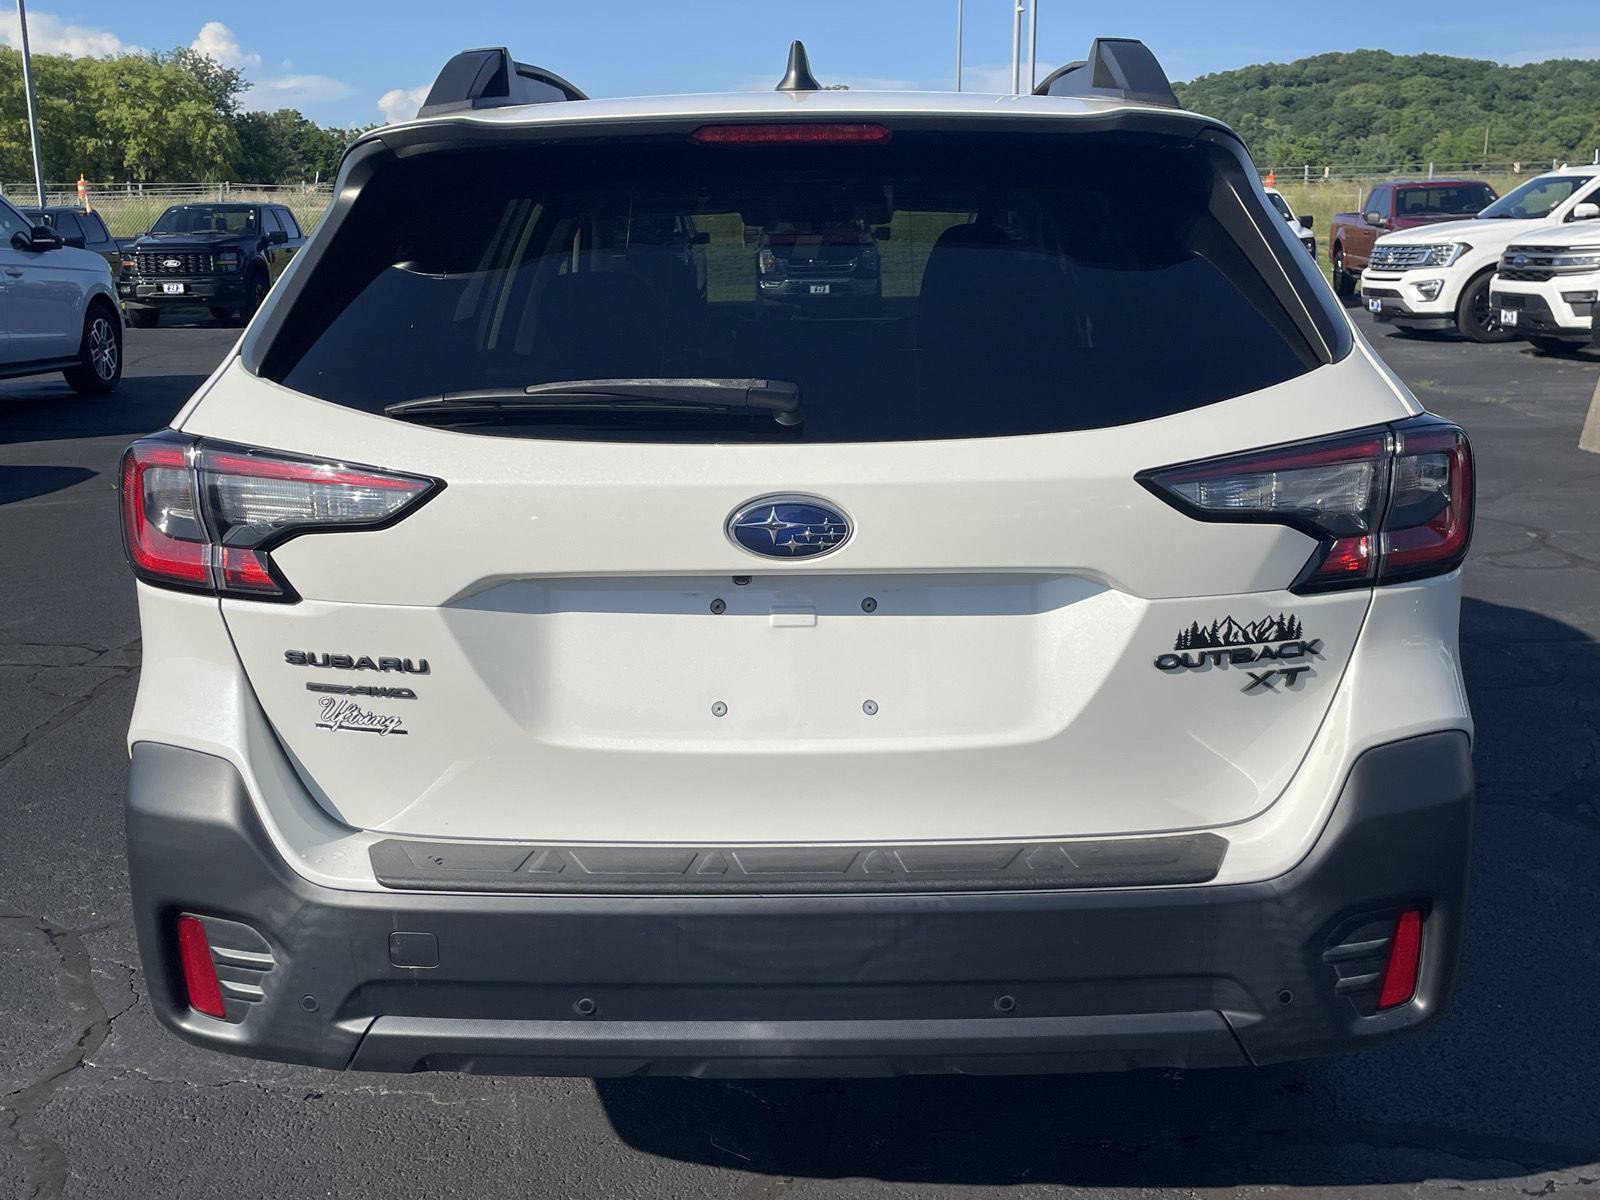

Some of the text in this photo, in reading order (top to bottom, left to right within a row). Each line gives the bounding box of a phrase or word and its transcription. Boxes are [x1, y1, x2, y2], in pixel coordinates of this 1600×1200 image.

[284, 649, 431, 675] SUBARU
[1154, 638, 1324, 670] OUTBACK
[1241, 665, 1311, 692] XT
